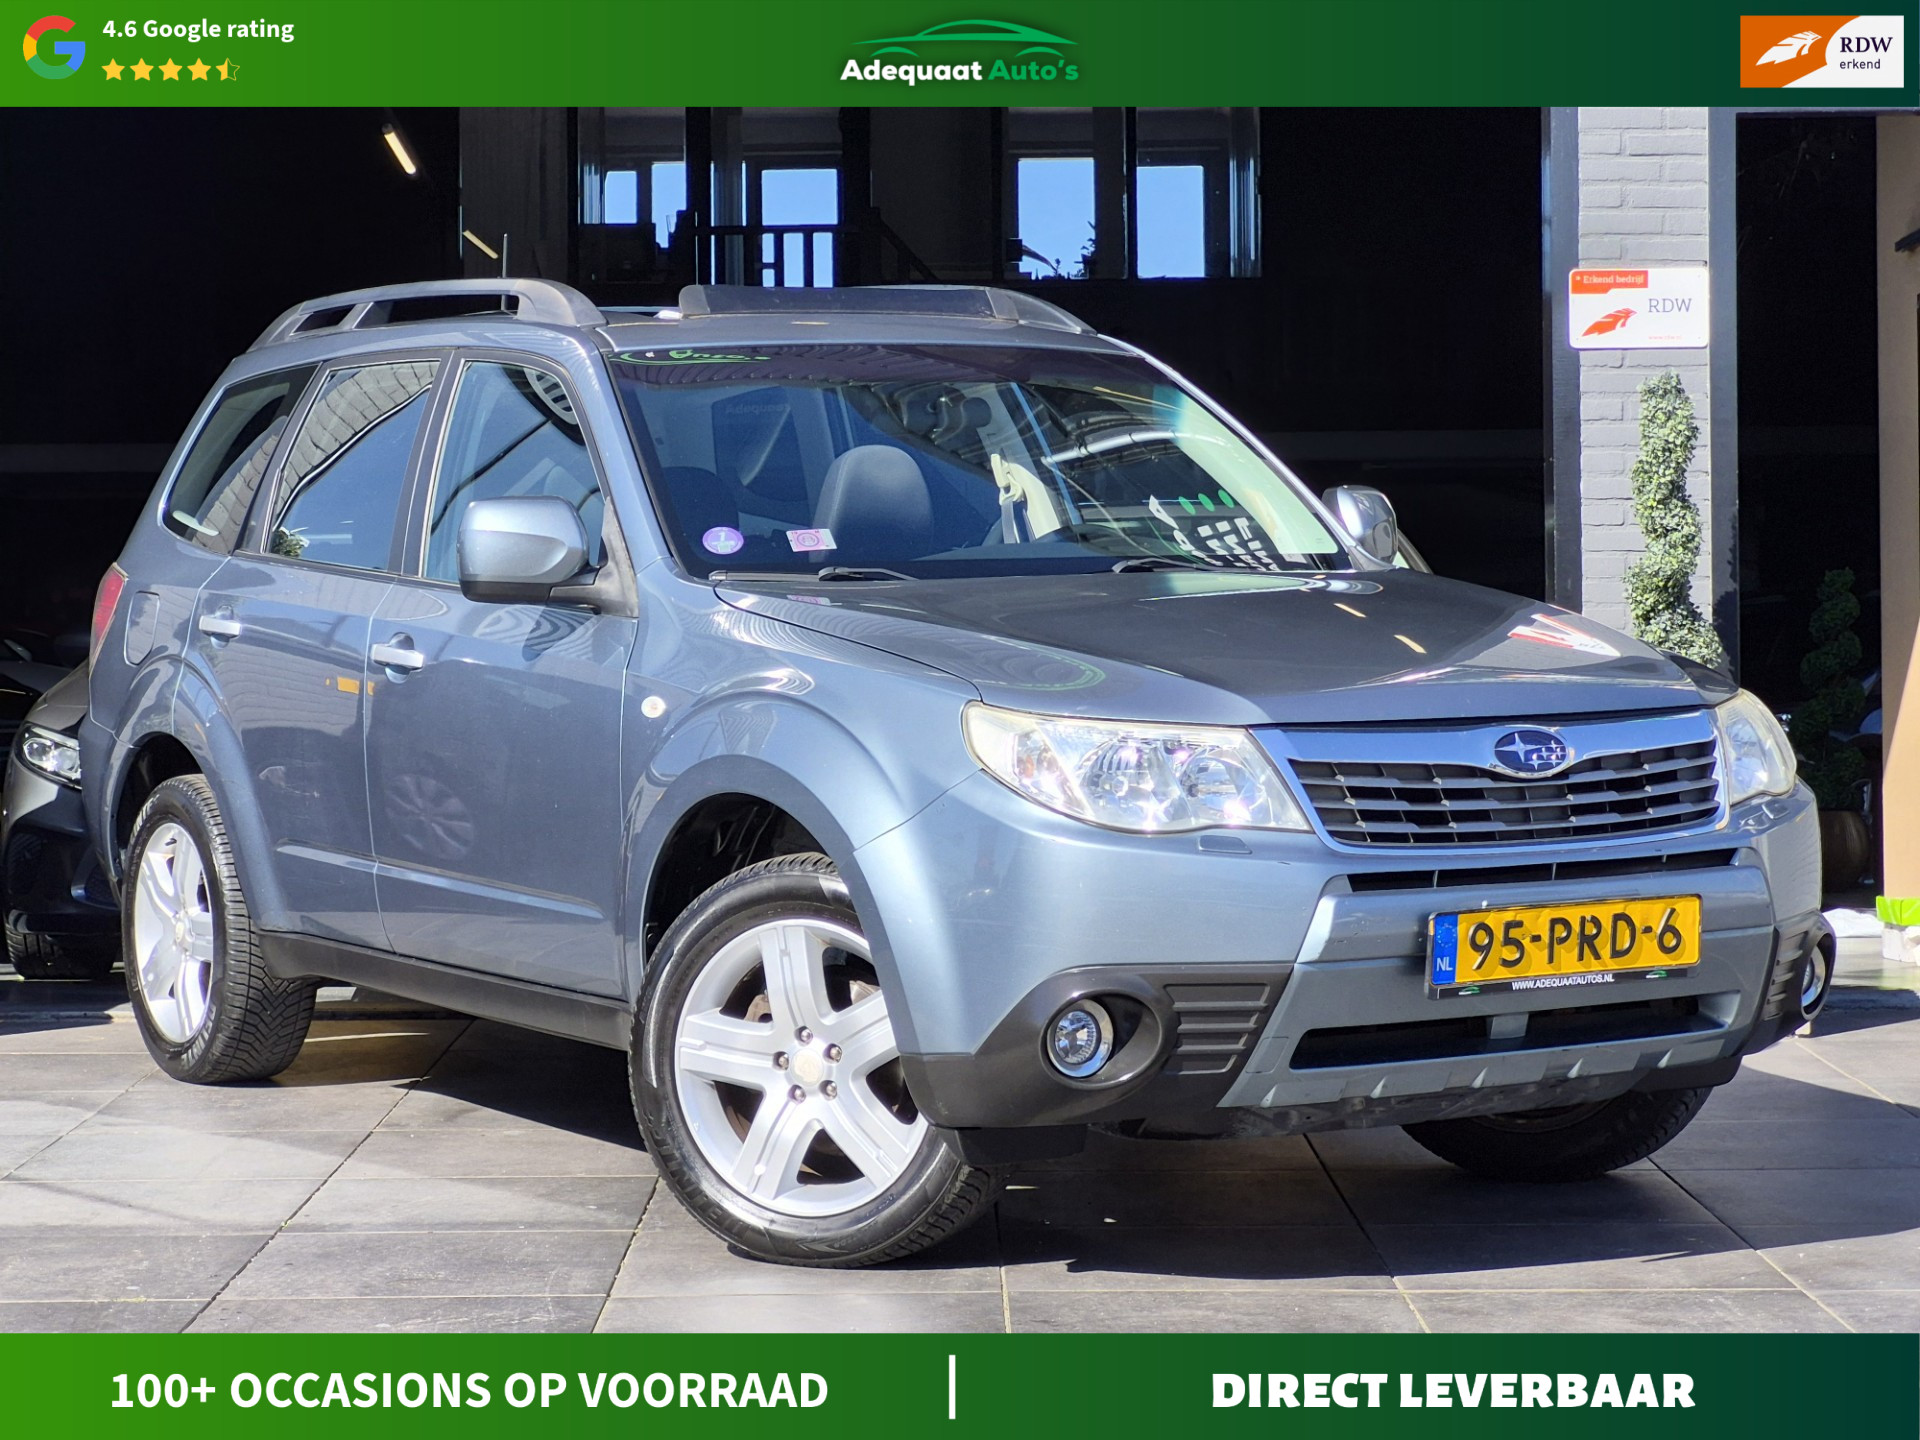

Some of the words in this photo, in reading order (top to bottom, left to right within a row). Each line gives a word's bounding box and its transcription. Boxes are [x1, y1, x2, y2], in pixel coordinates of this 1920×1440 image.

[1583, 275, 1614, 284] Erkend
[1648, 298, 1692, 313] RDW
[1467, 907, 1683, 971] 95-PRD-6
[1436, 957, 1454, 972] NL
[1511, 973, 1616, 991] WWW.ADEQUAATAUTOS.NL
